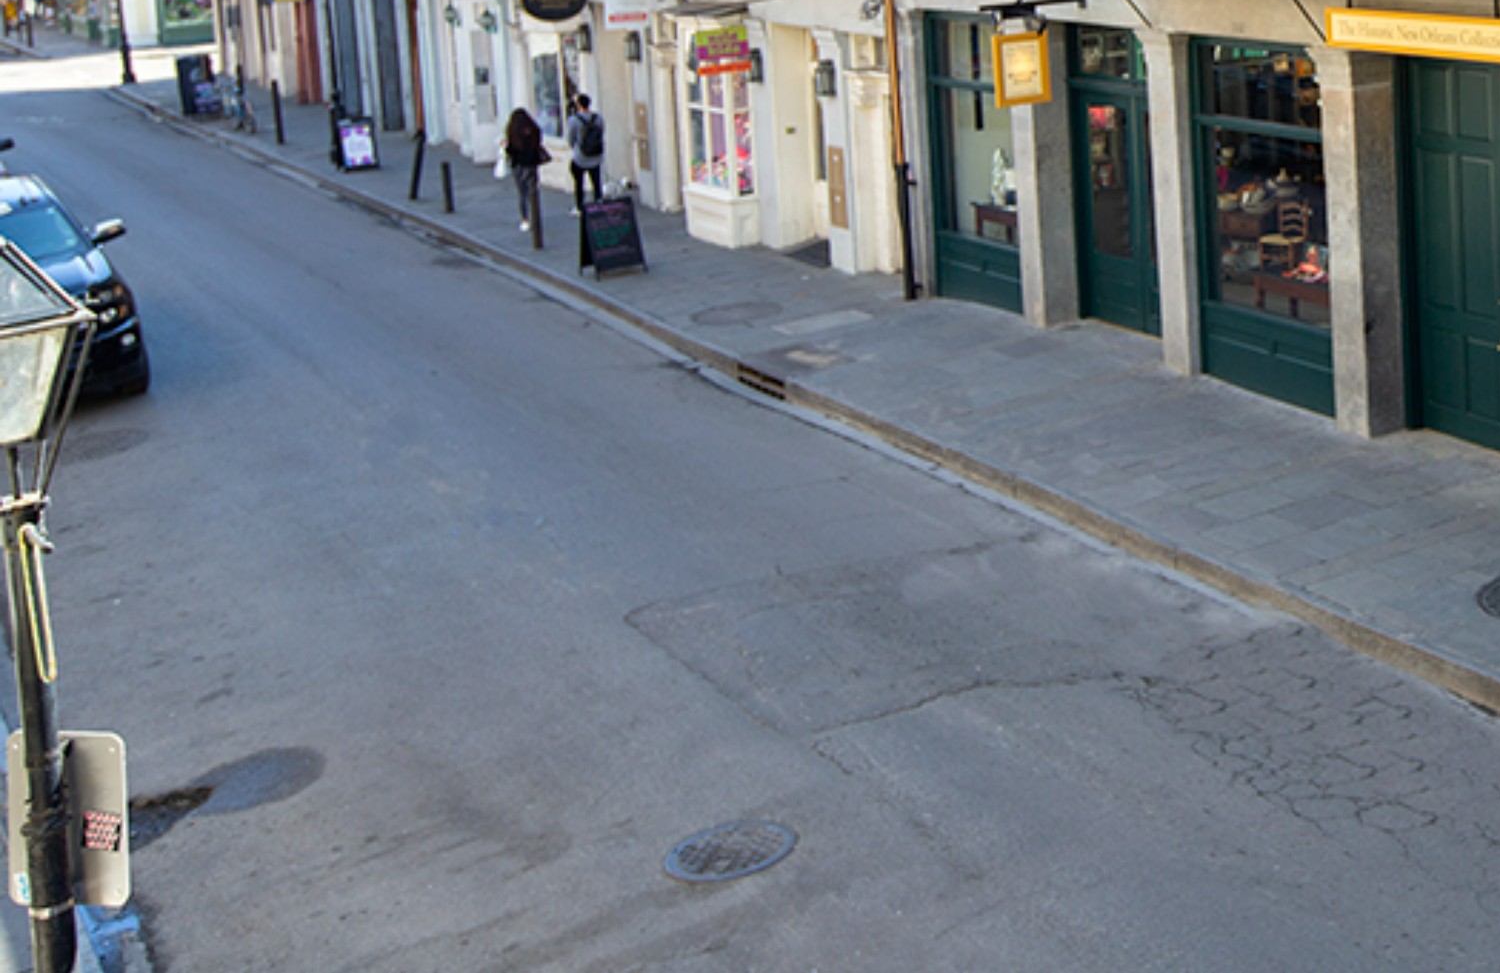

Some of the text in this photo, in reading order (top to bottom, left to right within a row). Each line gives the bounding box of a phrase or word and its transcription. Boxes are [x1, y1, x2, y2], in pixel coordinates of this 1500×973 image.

[1338, 19, 1355, 35] The
[1358, 21, 1392, 39] Historic
[1396, 25, 1418, 41] New
[1420, 25, 1458, 45] Orleans
